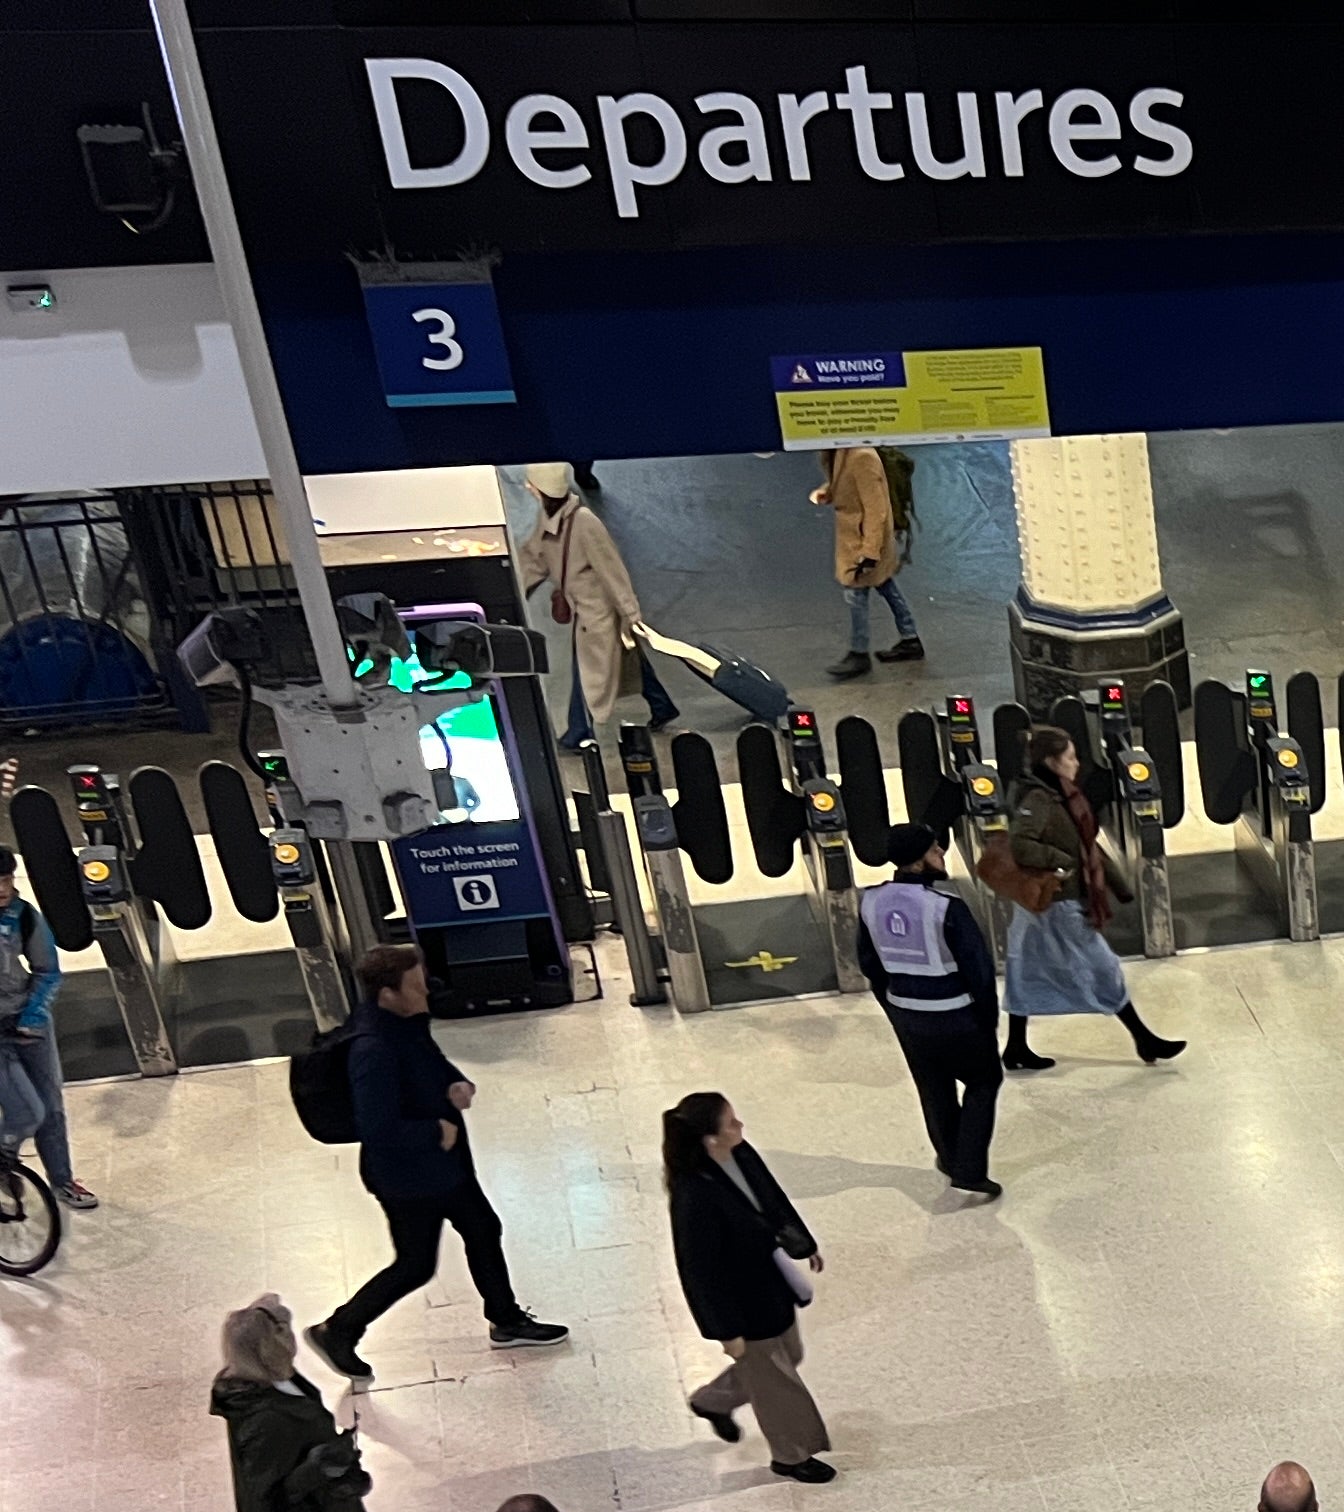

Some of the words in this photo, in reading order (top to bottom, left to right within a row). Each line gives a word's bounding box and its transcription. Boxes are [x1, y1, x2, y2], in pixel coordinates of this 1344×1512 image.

[364, 58, 1194, 218] Departures
[412, 308, 464, 371] 3
[815, 359, 886, 374] WARNING
[410, 846, 451, 859] Touch
[452, 844, 475, 856] the
[477, 842, 520, 854] screen
[420, 863, 440, 874] for
[443, 858, 519, 872] information
